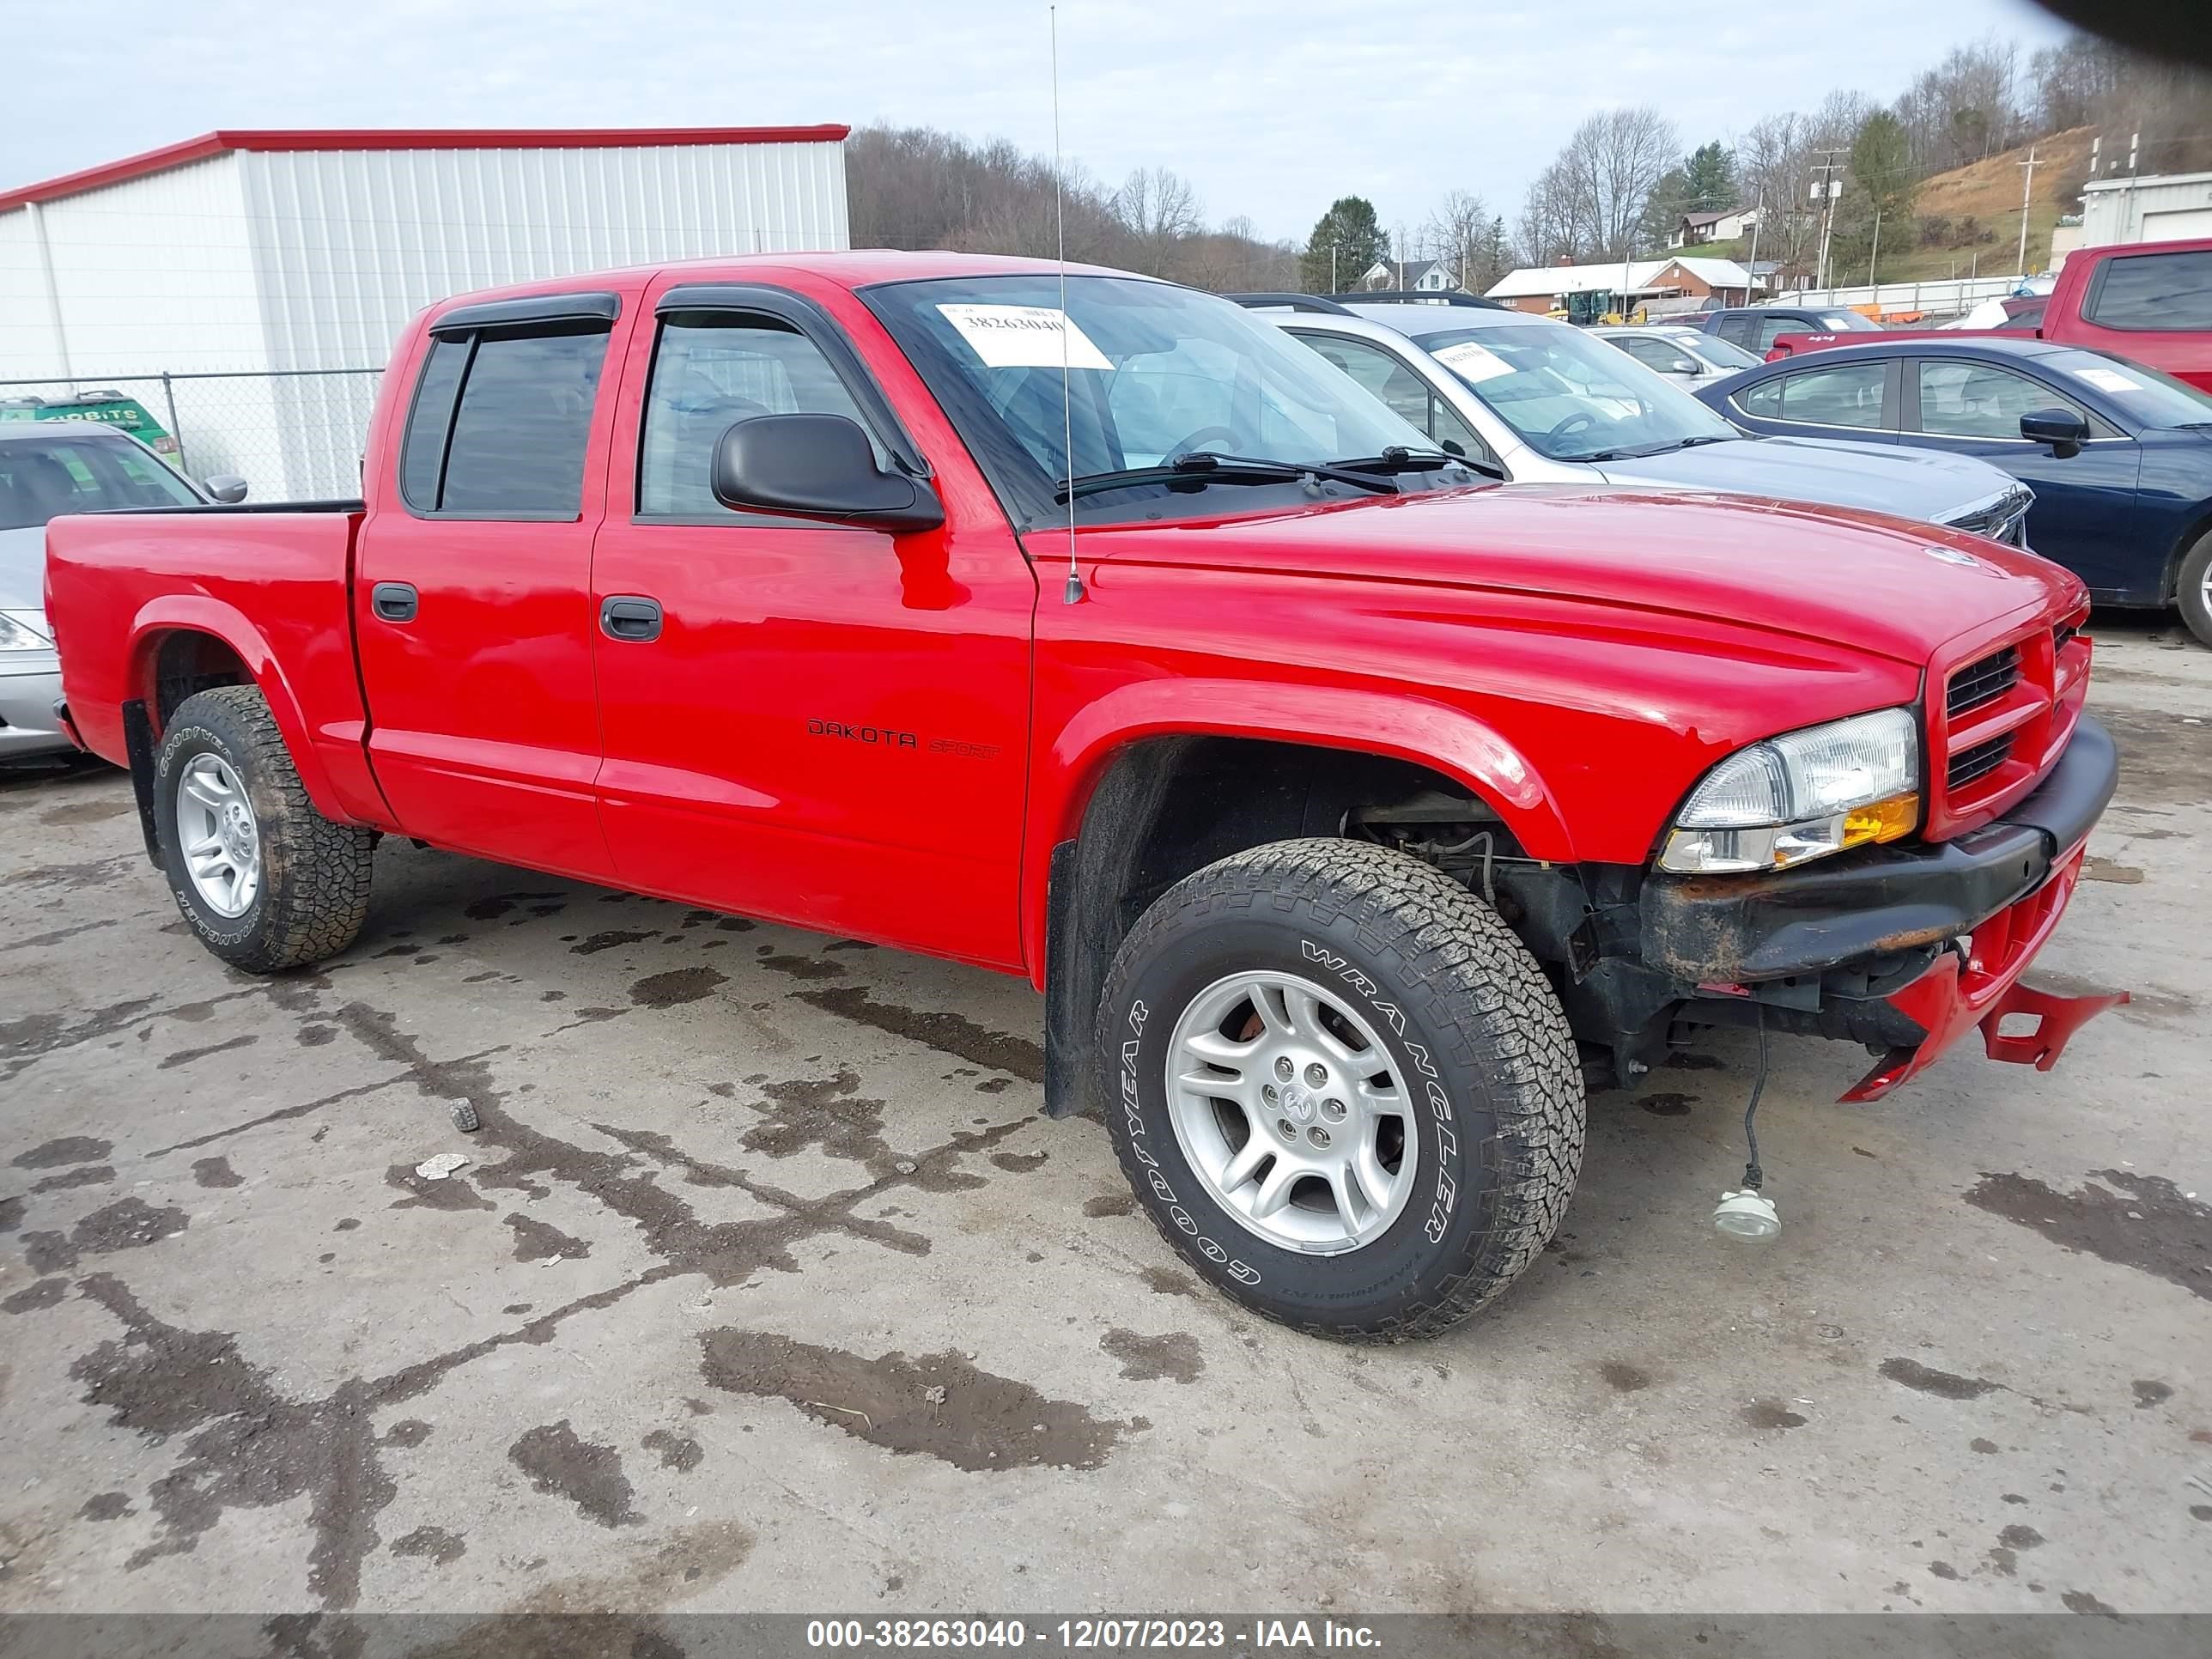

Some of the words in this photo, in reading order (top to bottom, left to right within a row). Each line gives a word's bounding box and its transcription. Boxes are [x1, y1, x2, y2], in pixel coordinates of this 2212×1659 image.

[963, 317, 1065, 332] 38263040
[807, 718, 918, 750] DAKOTA
[927, 738, 1001, 761] SPORT
[1121, 999, 1261, 1285] GOODYEAR
[1300, 939, 1457, 1245] WRANGLER
